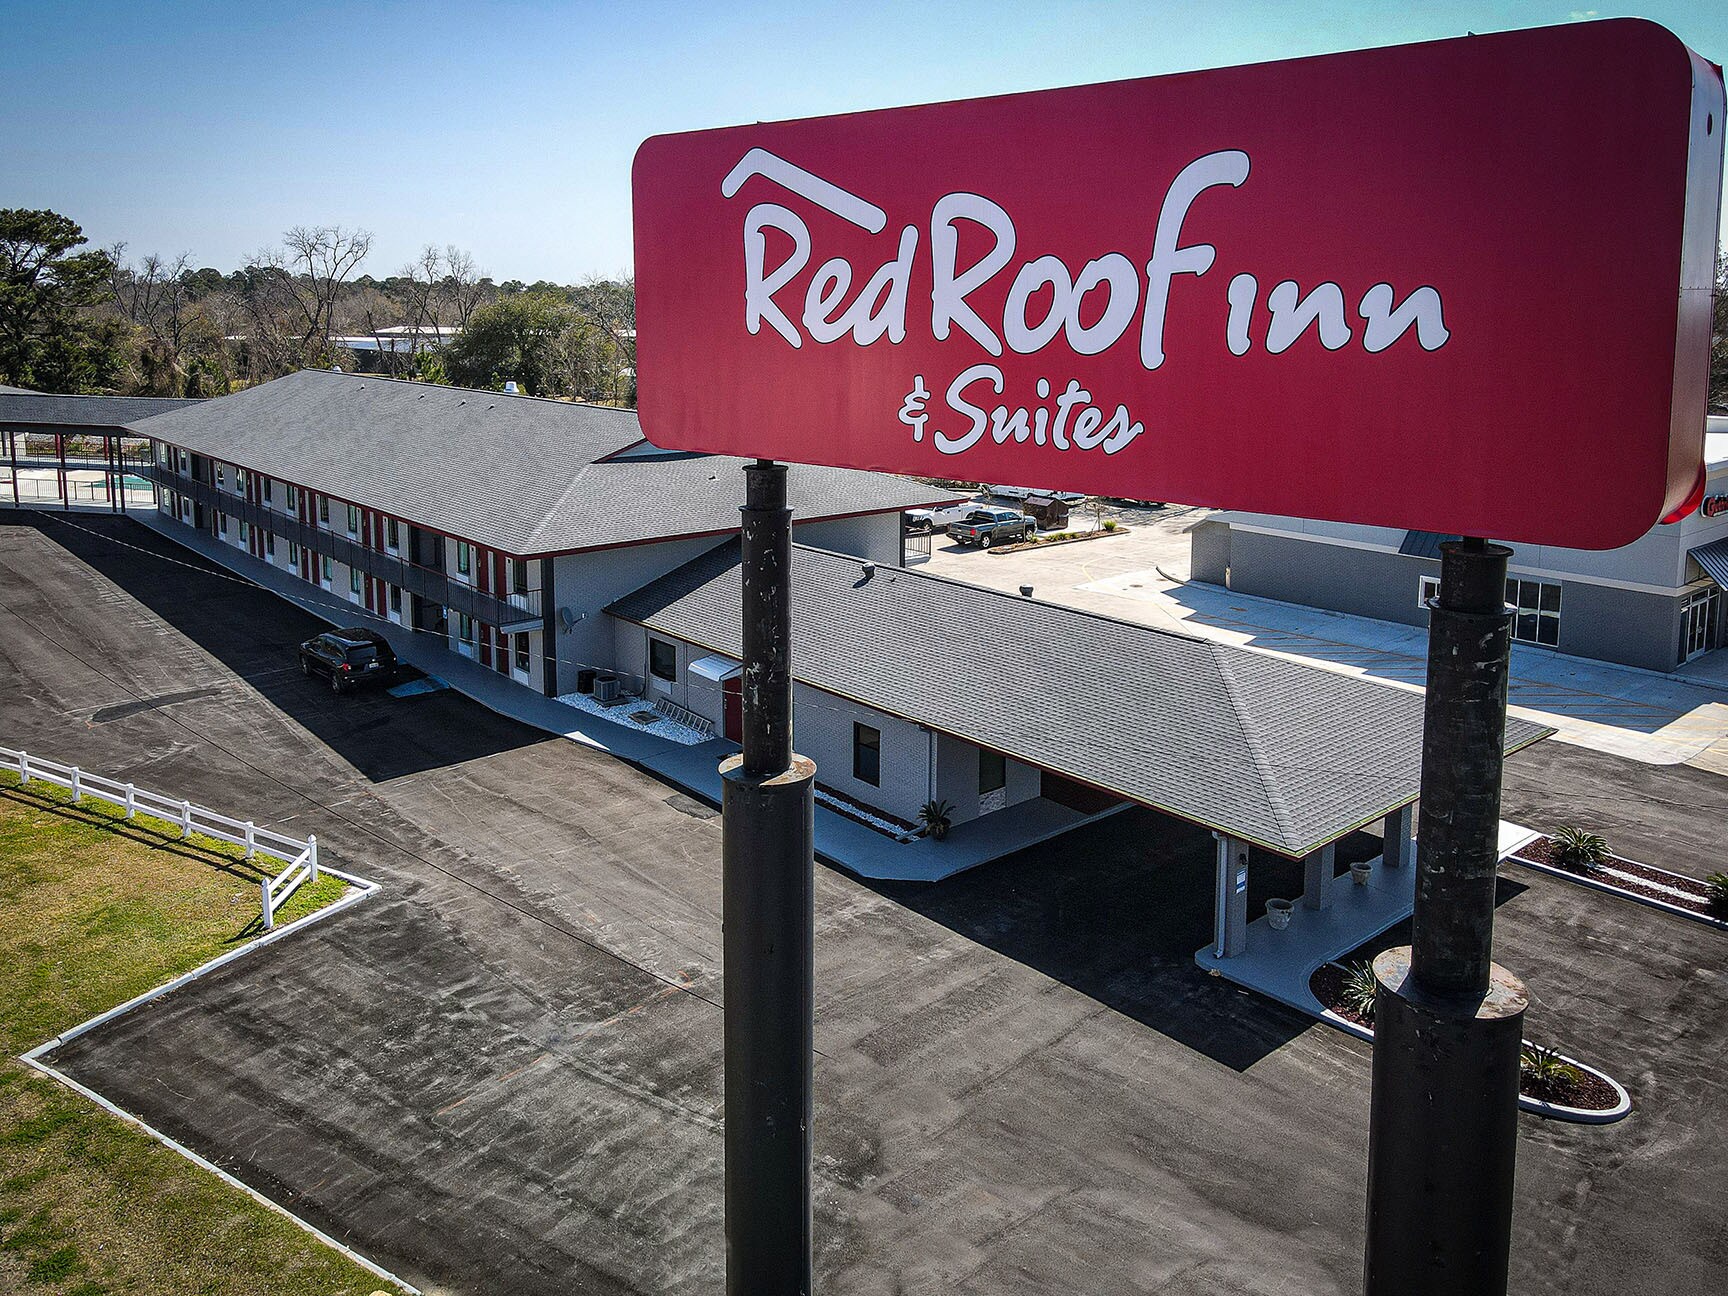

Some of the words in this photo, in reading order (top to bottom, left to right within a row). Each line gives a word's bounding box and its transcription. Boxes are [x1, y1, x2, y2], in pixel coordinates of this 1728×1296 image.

[743, 203, 919, 349] Red
[930, 150, 1250, 370] Roof
[898, 375, 931, 442] &
[934, 364, 1144, 455] Suites
